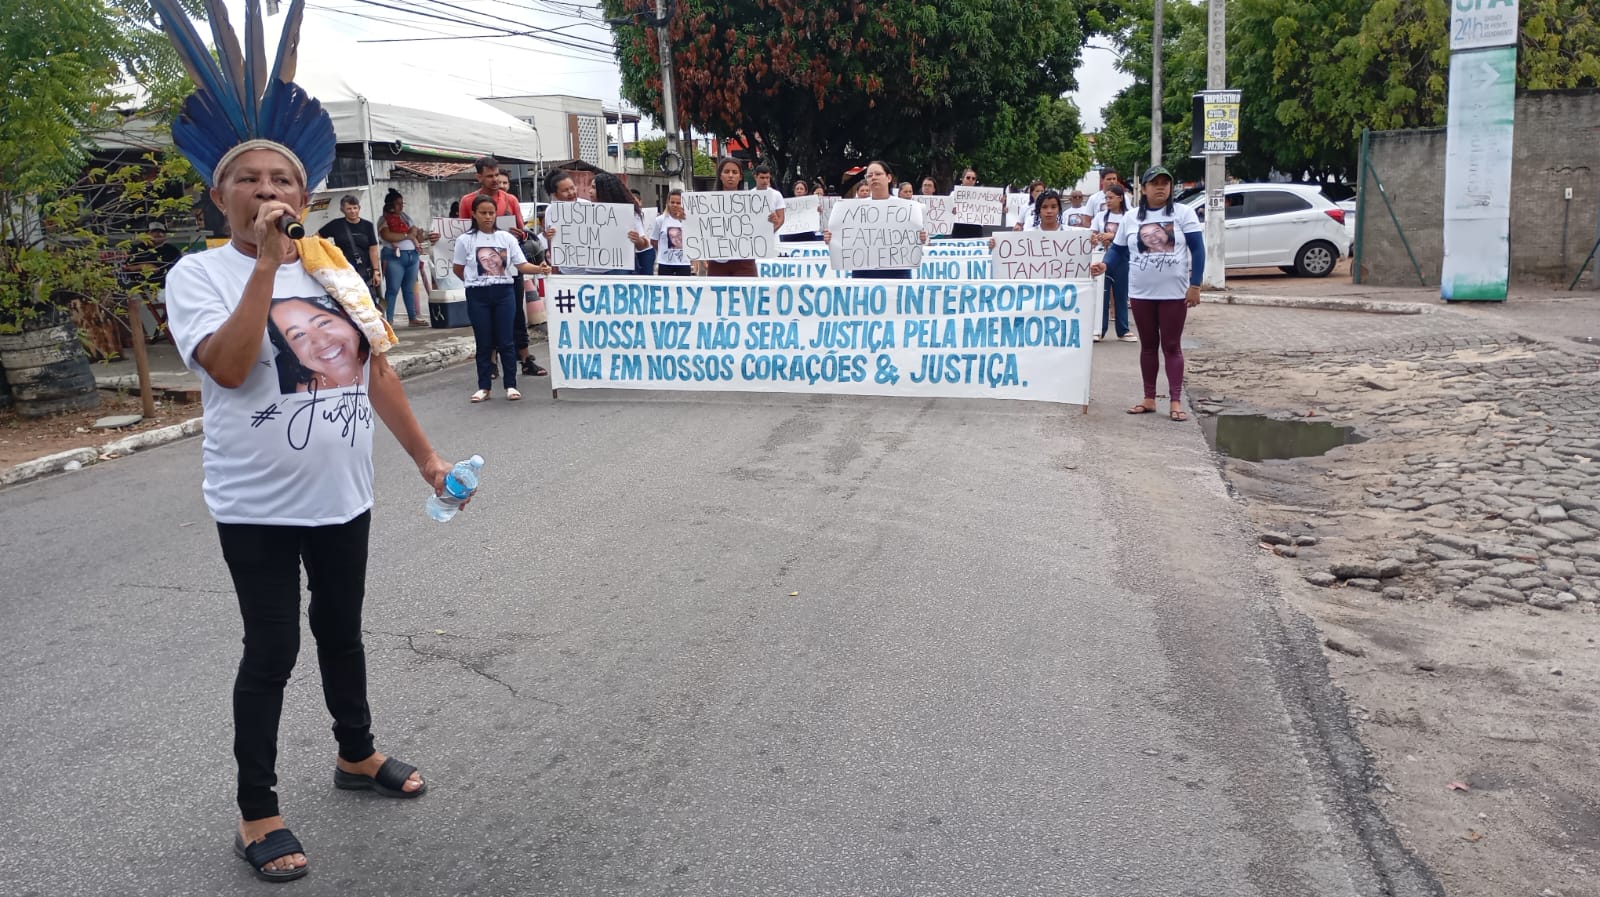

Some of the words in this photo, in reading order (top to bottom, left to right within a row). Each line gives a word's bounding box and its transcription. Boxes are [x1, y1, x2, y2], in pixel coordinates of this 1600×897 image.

[957, 190, 976, 200] ERRO
[550, 201, 618, 228] JUSTIÇA
[842, 204, 880, 224] NÃO
[886, 204, 912, 223] FOI
[577, 225, 601, 246] UM
[699, 214, 754, 238] MENOS
[552, 245, 624, 268] DIREITO!!!
[841, 246, 870, 270] FOI
[878, 245, 922, 269] ERRO
[998, 239, 1012, 259] O
[1001, 258, 1091, 280] TAMBÉM
[554, 284, 704, 316] #GABRIELLY
[710, 285, 771, 317] TEVE
[776, 284, 793, 316] O
[798, 283, 887, 318] SONHO
[896, 283, 1081, 316] INTERROPIDO.
[558, 320, 572, 349] A
[578, 320, 646, 350] NOSSA
[650, 321, 692, 350] VOZ
[696, 317, 741, 350] NÃO
[809, 320, 895, 353] JUSTIÇA
[903, 319, 957, 349] PELA
[962, 316, 1081, 349] MEMORIA
[558, 353, 602, 381] VIVA
[609, 353, 642, 381] EM
[647, 354, 734, 382] NOSSOS
[740, 350, 869, 386] CORAÇÕES
[874, 353, 900, 385] &
[910, 352, 1029, 388] JUSTIÇA.
